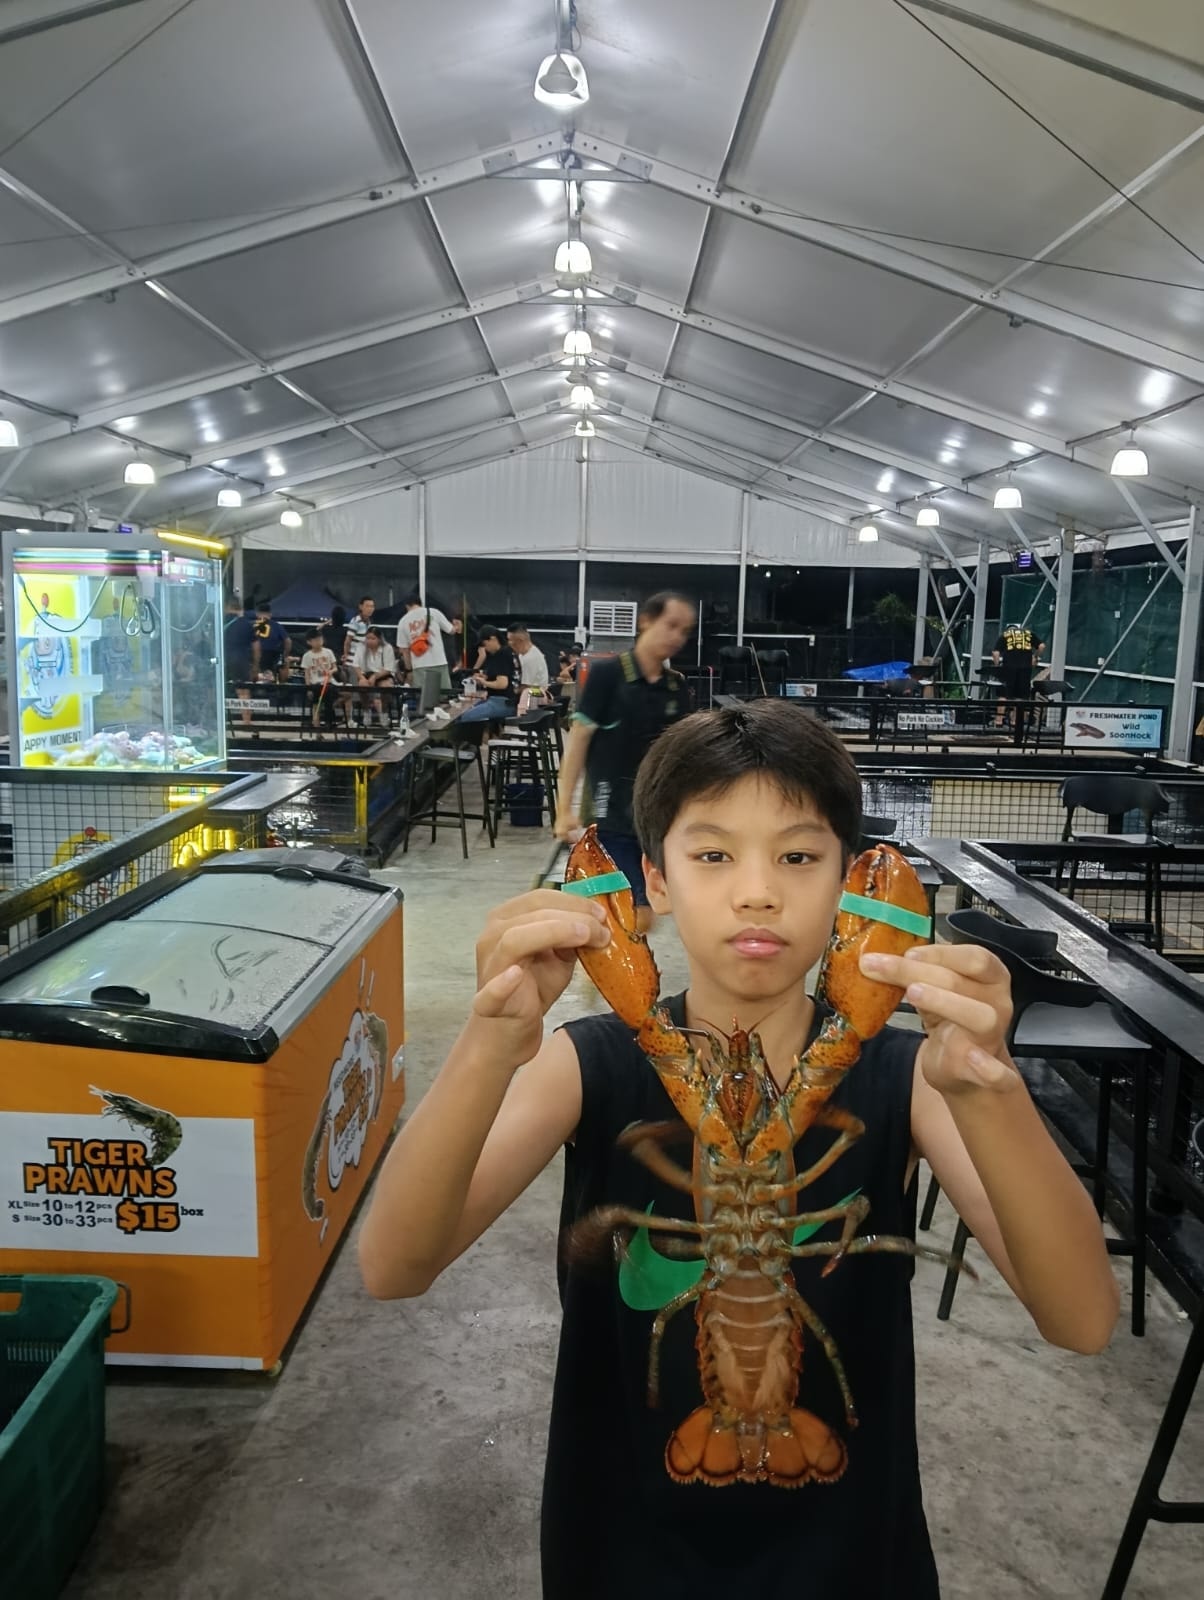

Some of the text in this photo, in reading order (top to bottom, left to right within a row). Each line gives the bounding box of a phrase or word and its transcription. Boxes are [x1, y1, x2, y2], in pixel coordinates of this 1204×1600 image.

[1089, 712, 1137, 720] FRESHWATER
[24, 736, 47, 751] APPY
[47, 1136, 148, 1167] TIGER
[22, 1162, 177, 1198] PRAWNS
[8, 1200, 23, 1209] XL
[42, 1199, 63, 1212] 10
[75, 1200, 96, 1213] 12
[116, 1197, 181, 1234] $15
[181, 1206, 204, 1216] box
[12, 1214, 20, 1223] S
[24, 1214, 40, 1222] Size
[42, 1213, 63, 1226] 30
[65, 1217, 74, 1225] to
[75, 1214, 97, 1228] 33
